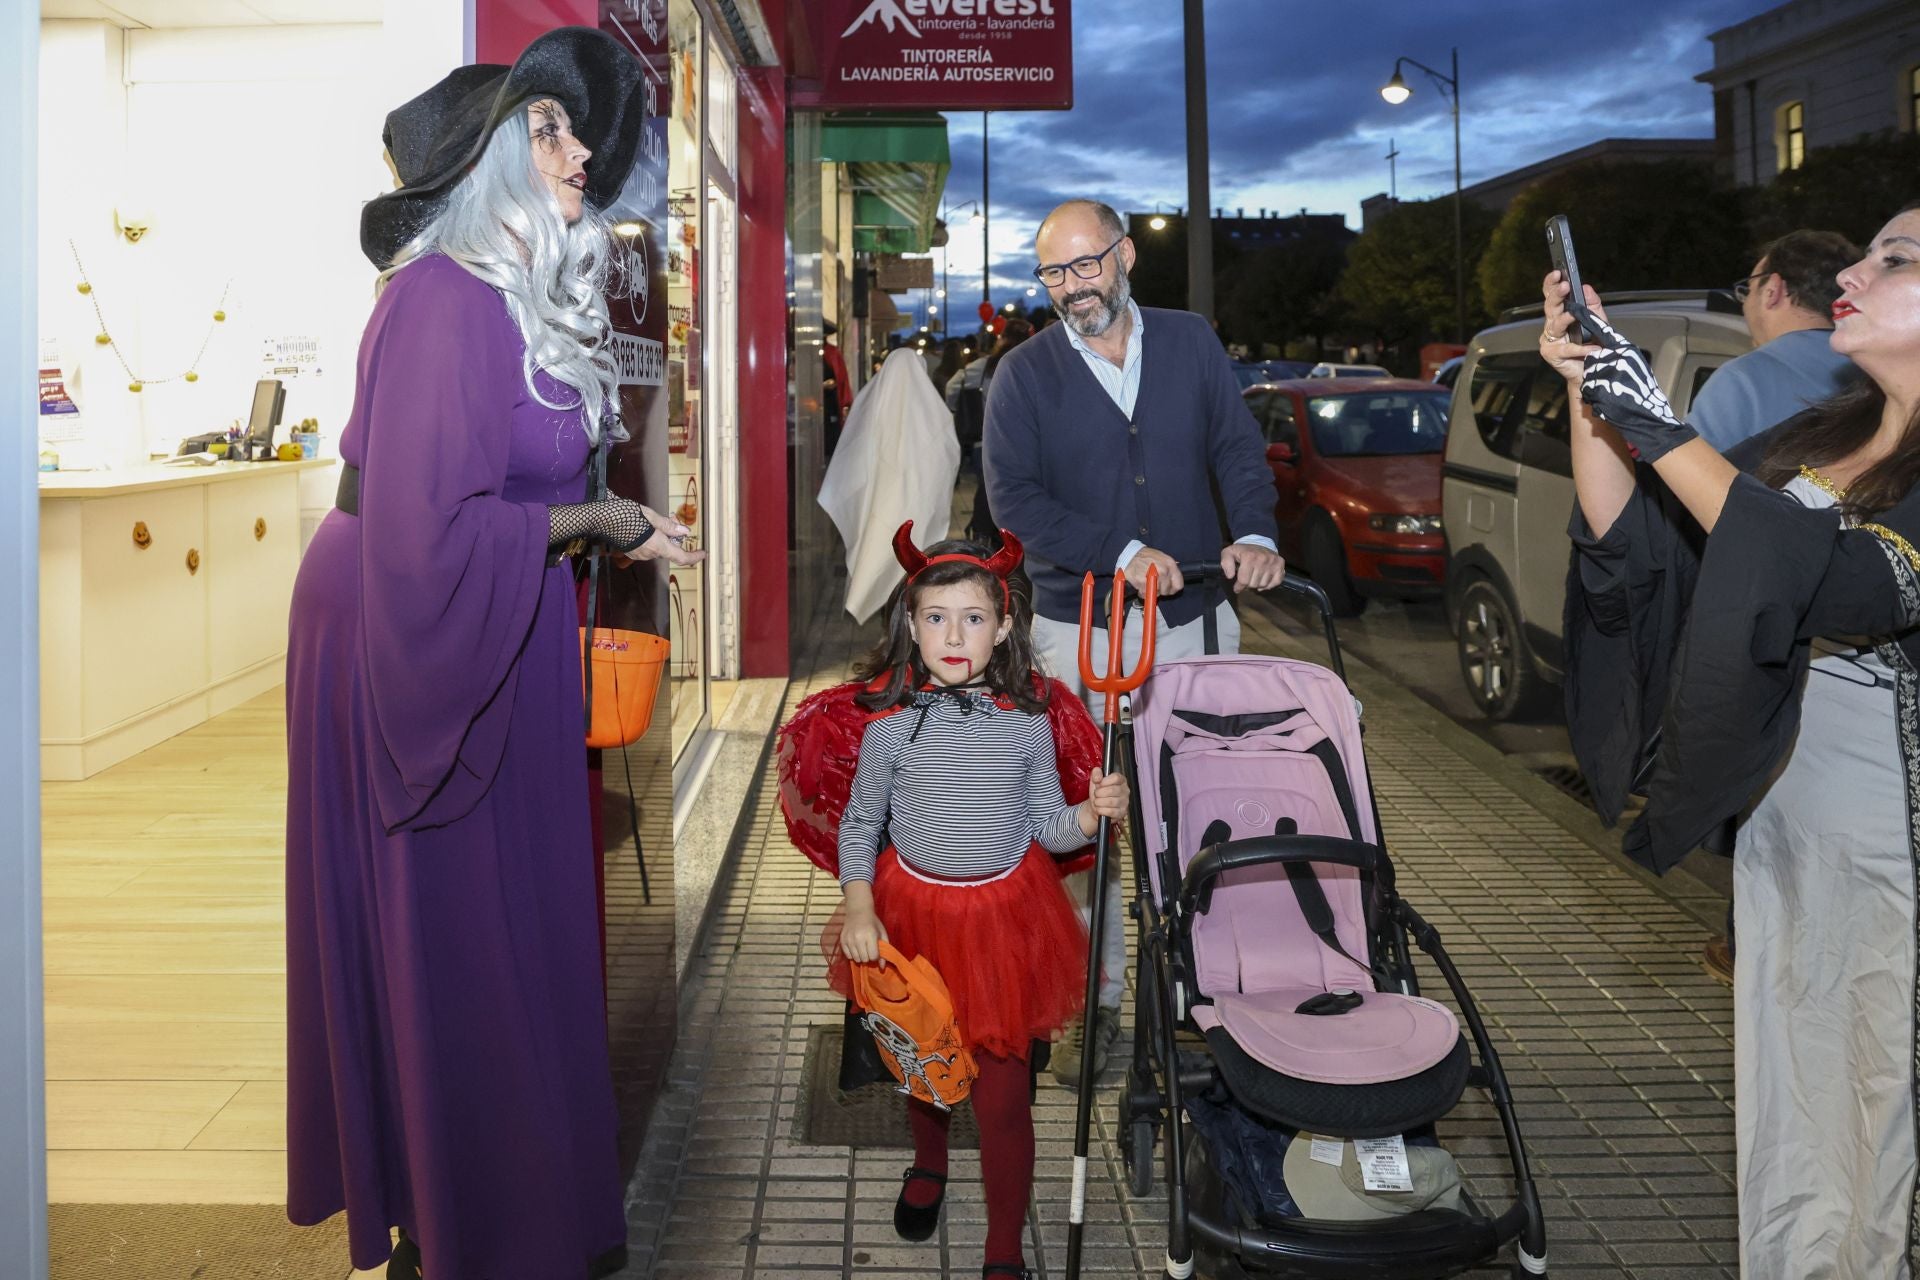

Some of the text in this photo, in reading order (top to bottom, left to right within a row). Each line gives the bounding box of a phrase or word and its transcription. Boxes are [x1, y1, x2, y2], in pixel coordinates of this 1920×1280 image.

[905, 0, 1055, 15] everest
[917, 15, 977, 29] tintorería
[987, 15, 1055, 29] lavandería
[958, 31, 1013, 40] desde 1958
[901, 45, 993, 63] TINTORERÍA
[841, 64, 1054, 82] LAVANDERÍA AUTOSERVICIO
[620, 339, 635, 377] 985
[637, 342, 644, 378] 13
[645, 344, 653, 379] 39
